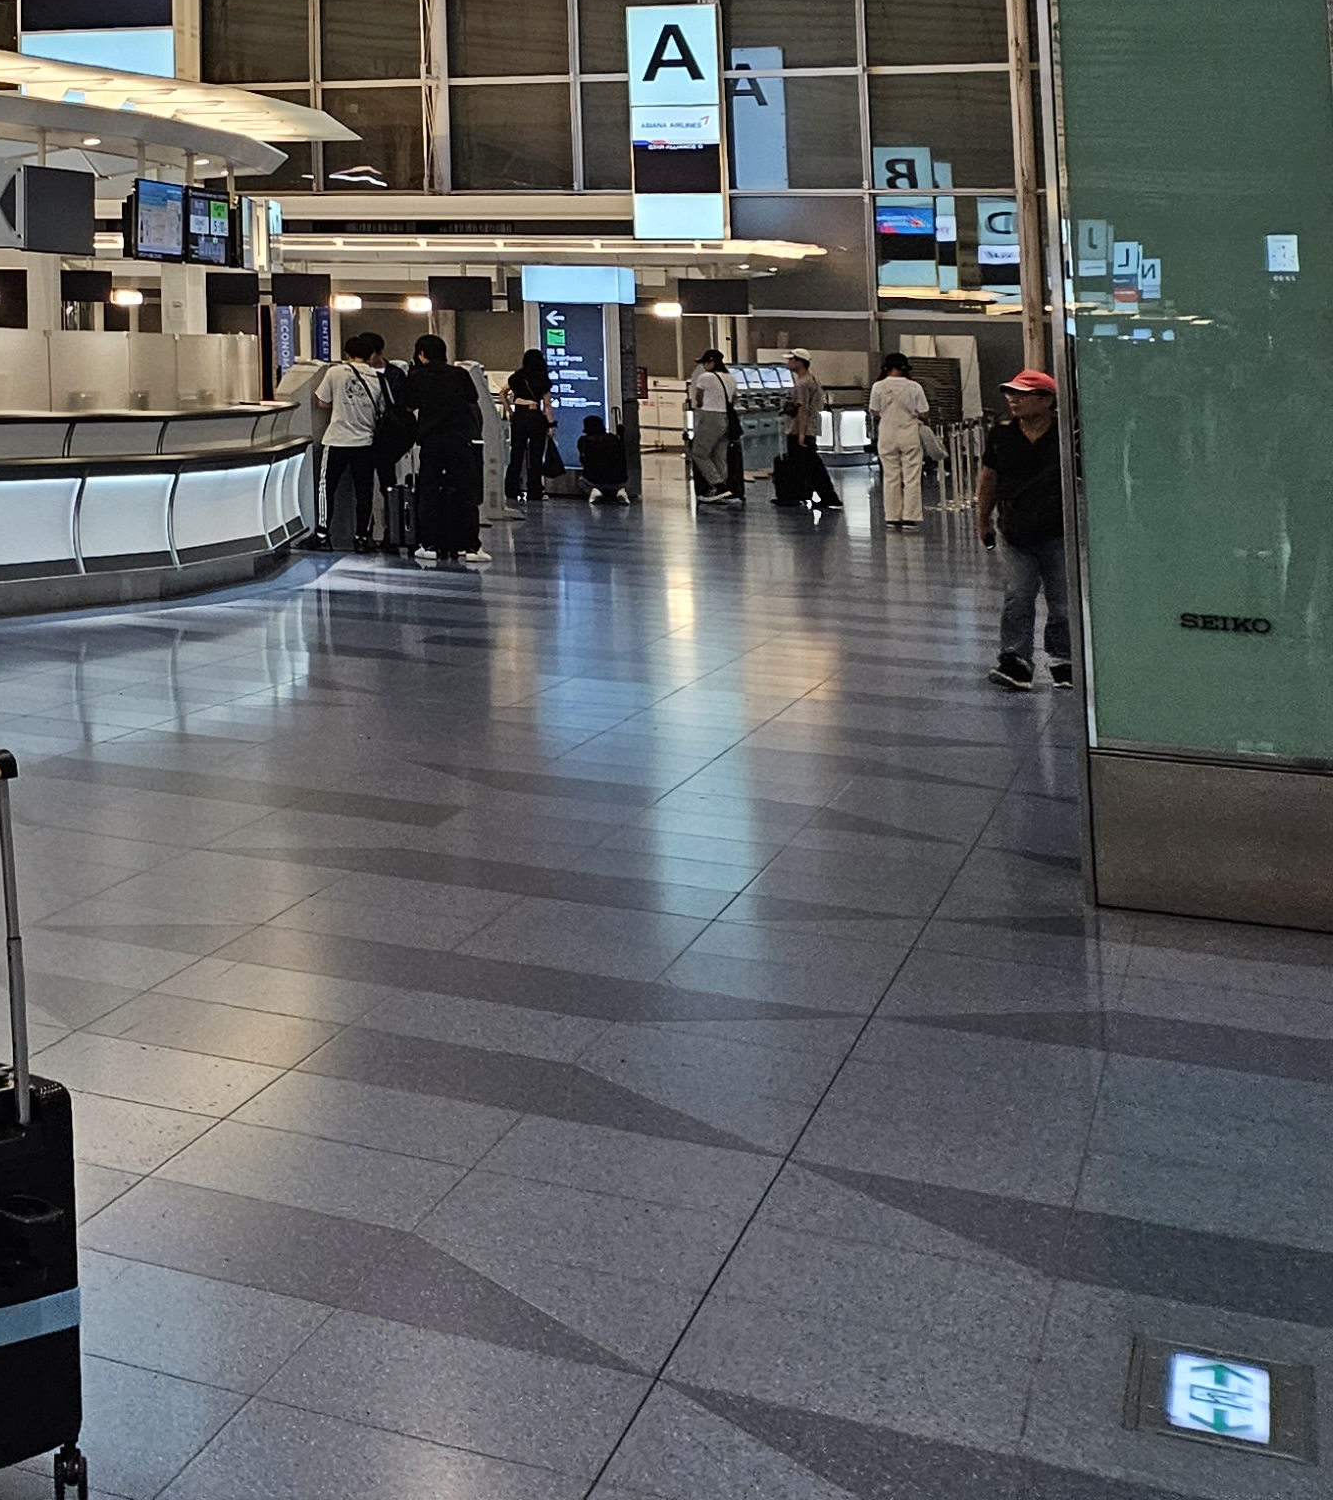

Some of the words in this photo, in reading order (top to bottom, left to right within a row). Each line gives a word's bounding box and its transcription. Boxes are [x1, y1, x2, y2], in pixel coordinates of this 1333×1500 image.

[642, 24, 705, 81] A
[280, 319, 290, 373] ECONOM
[1180, 613, 1271, 634] SEIKO
